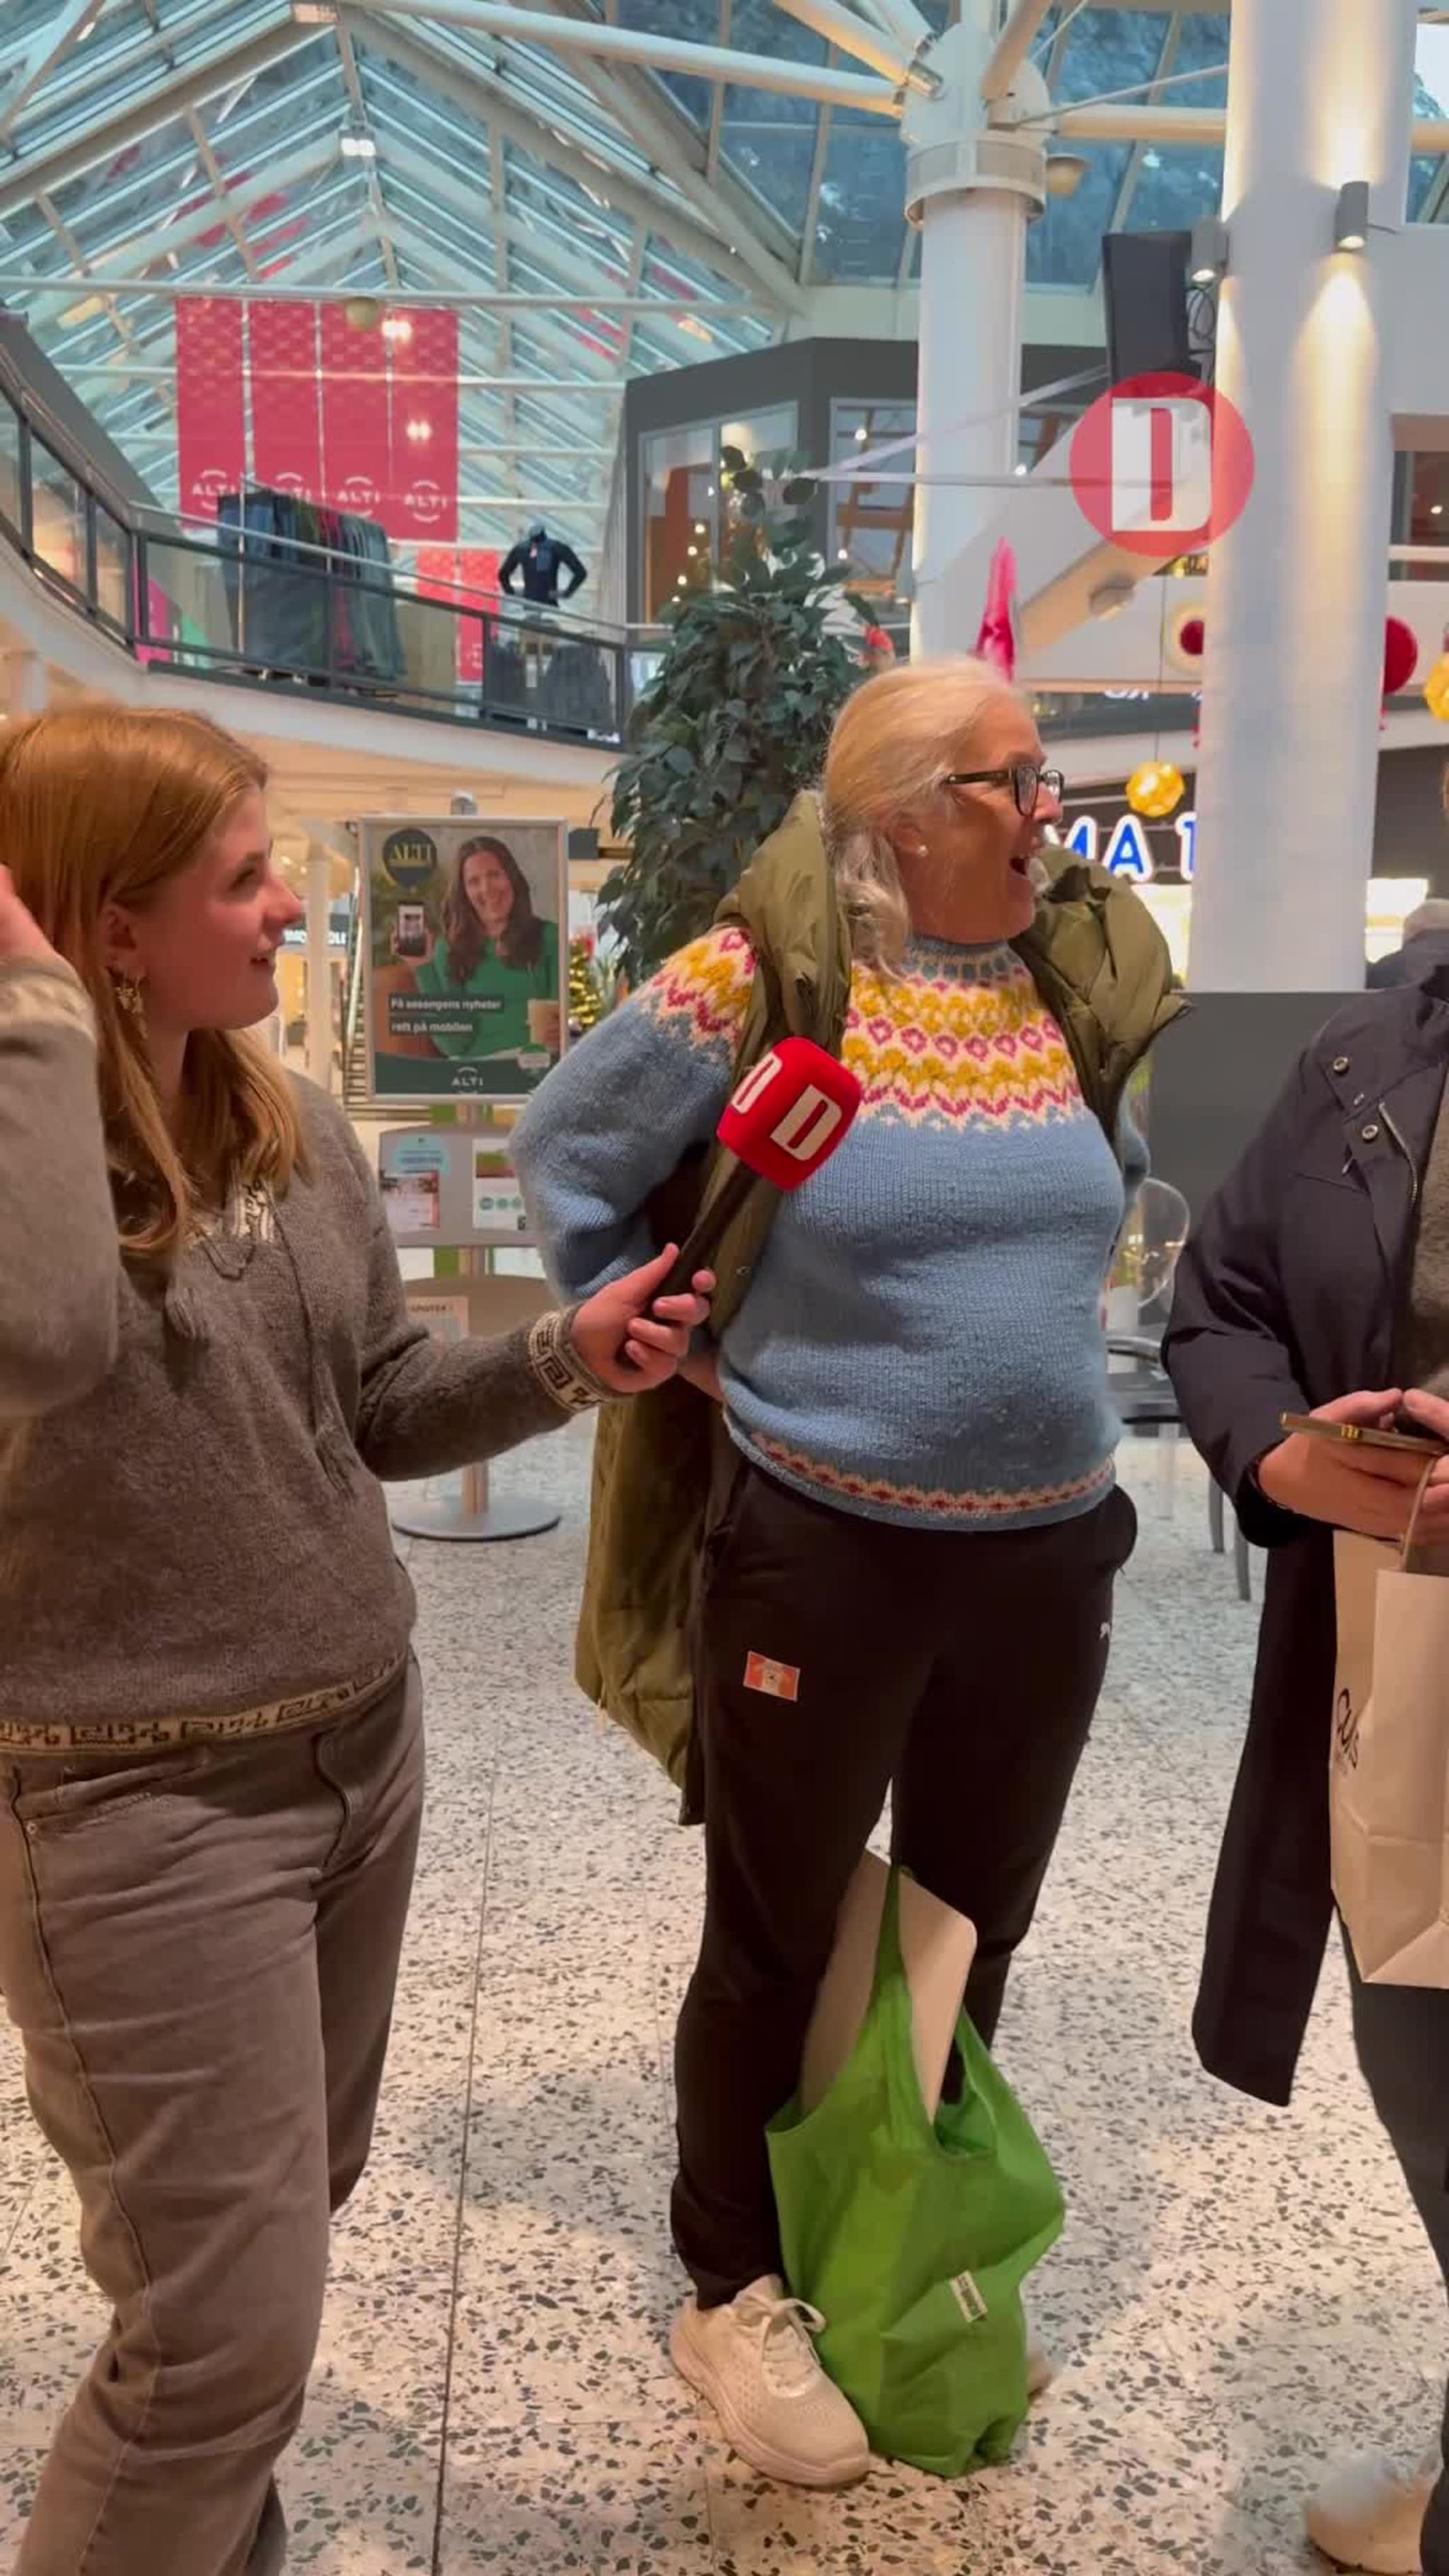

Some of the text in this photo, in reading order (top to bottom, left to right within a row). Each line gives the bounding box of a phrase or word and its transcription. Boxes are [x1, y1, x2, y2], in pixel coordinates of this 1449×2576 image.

[192, 483, 236, 496] ALTI
[336, 490, 381, 504] ALTI
[403, 493, 448, 509] ALTI
[412, 1021, 427, 1034] på
[451, 1077, 483, 1087] ALTI
[769, 1083, 843, 1161] D
